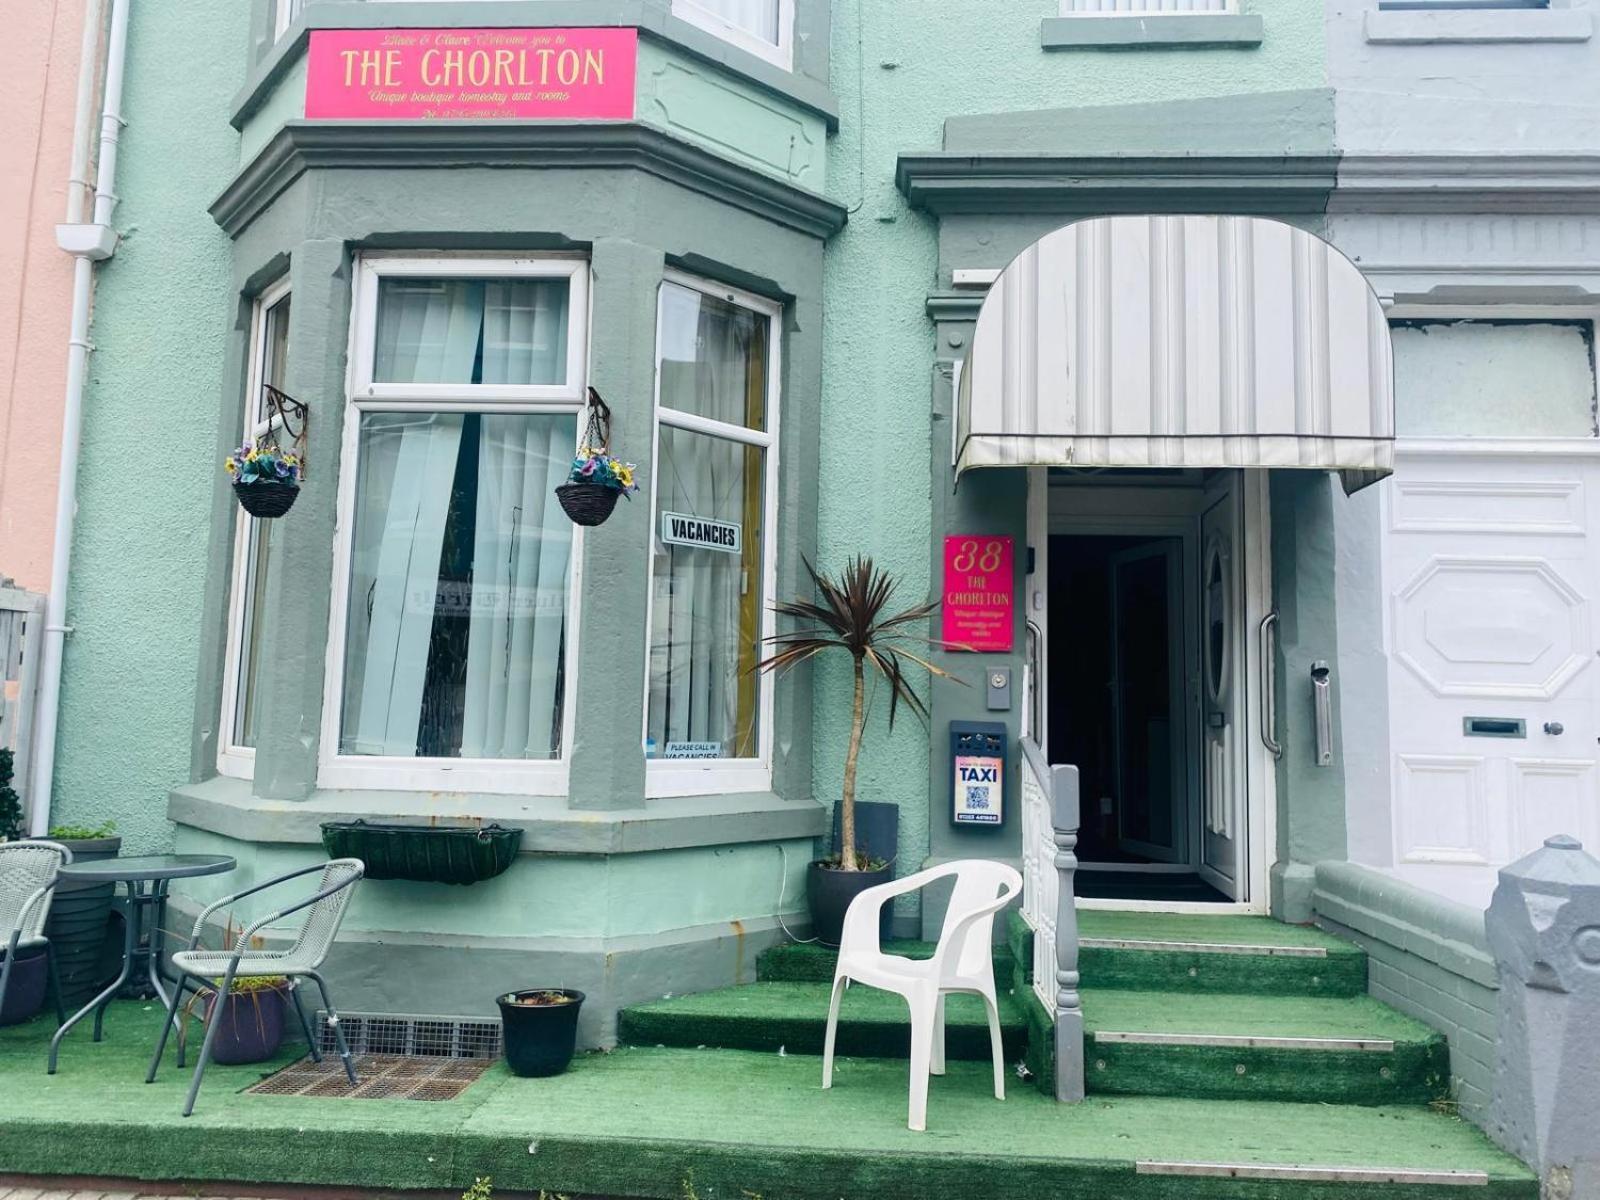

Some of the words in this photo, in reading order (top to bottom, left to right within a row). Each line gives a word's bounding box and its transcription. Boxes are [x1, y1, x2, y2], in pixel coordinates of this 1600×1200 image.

[555, 34, 567, 45] to
[340, 50, 403, 87] THE
[421, 48, 604, 87] CHORLTON
[368, 90, 407, 107] Unique
[410, 91, 453, 106] boutique
[458, 91, 507, 107] homestay
[511, 92, 532, 102] and
[536, 92, 570, 103] rooms
[671, 518, 735, 547] VACANCIES
[953, 540, 1003, 573] 38
[967, 575, 987, 589] THE
[947, 591, 1009, 606] CHORLTON
[959, 767, 998, 783] TAXI
